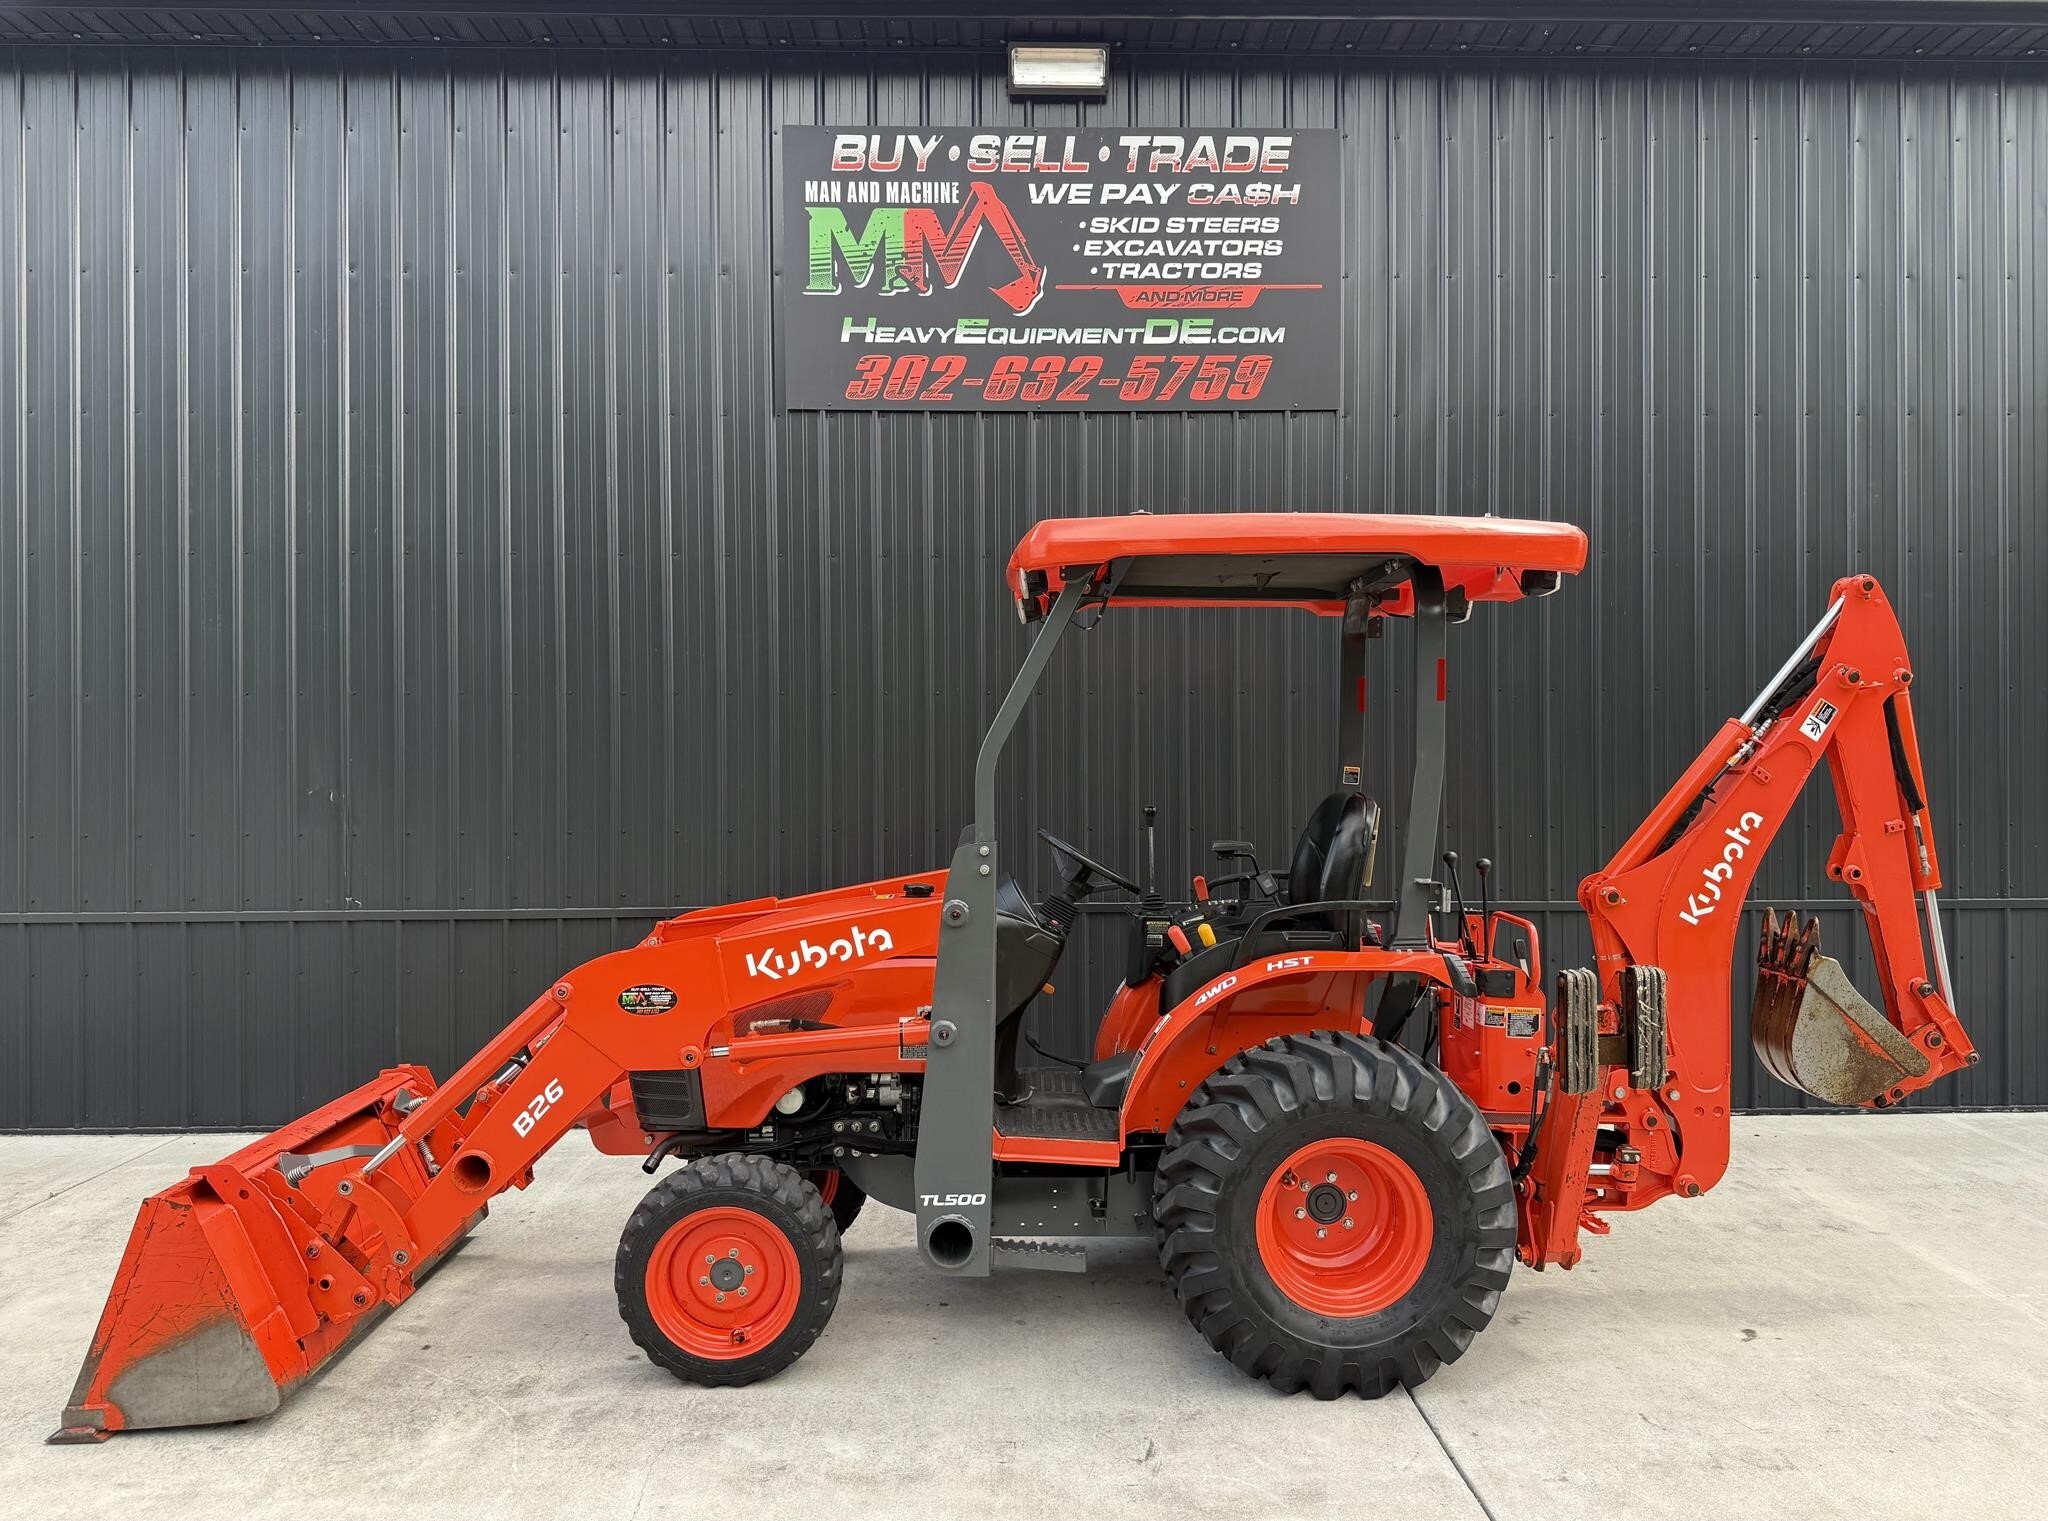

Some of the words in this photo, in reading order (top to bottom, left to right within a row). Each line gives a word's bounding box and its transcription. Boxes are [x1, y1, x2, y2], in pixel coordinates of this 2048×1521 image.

[832, 134, 944, 172] BUY
[967, 134, 1090, 173] SELL
[1118, 135, 1293, 173] TRADE
[804, 180, 841, 203] MAN
[847, 181, 880, 203] AND
[886, 181, 960, 204] MACHINE
[1028, 183, 1093, 205] WE
[1099, 183, 1181, 205] PAY
[1187, 182, 1301, 206] CA$H
[1089, 217, 1161, 234] SKID
[1165, 217, 1281, 234] STEERS
[1083, 239, 1284, 257] EXCAVATORS
[1102, 262, 1263, 280] TRACTORS
[844, 354, 1274, 401] 302-632-5759
[1678, 811, 1764, 926] Kubota
[745, 925, 894, 980] Kubota
[1266, 955, 1315, 972] HST
[1194, 975, 1238, 1007] 4WD
[511, 1077, 564, 1139] B26
[919, 1193, 987, 1207] TL500
